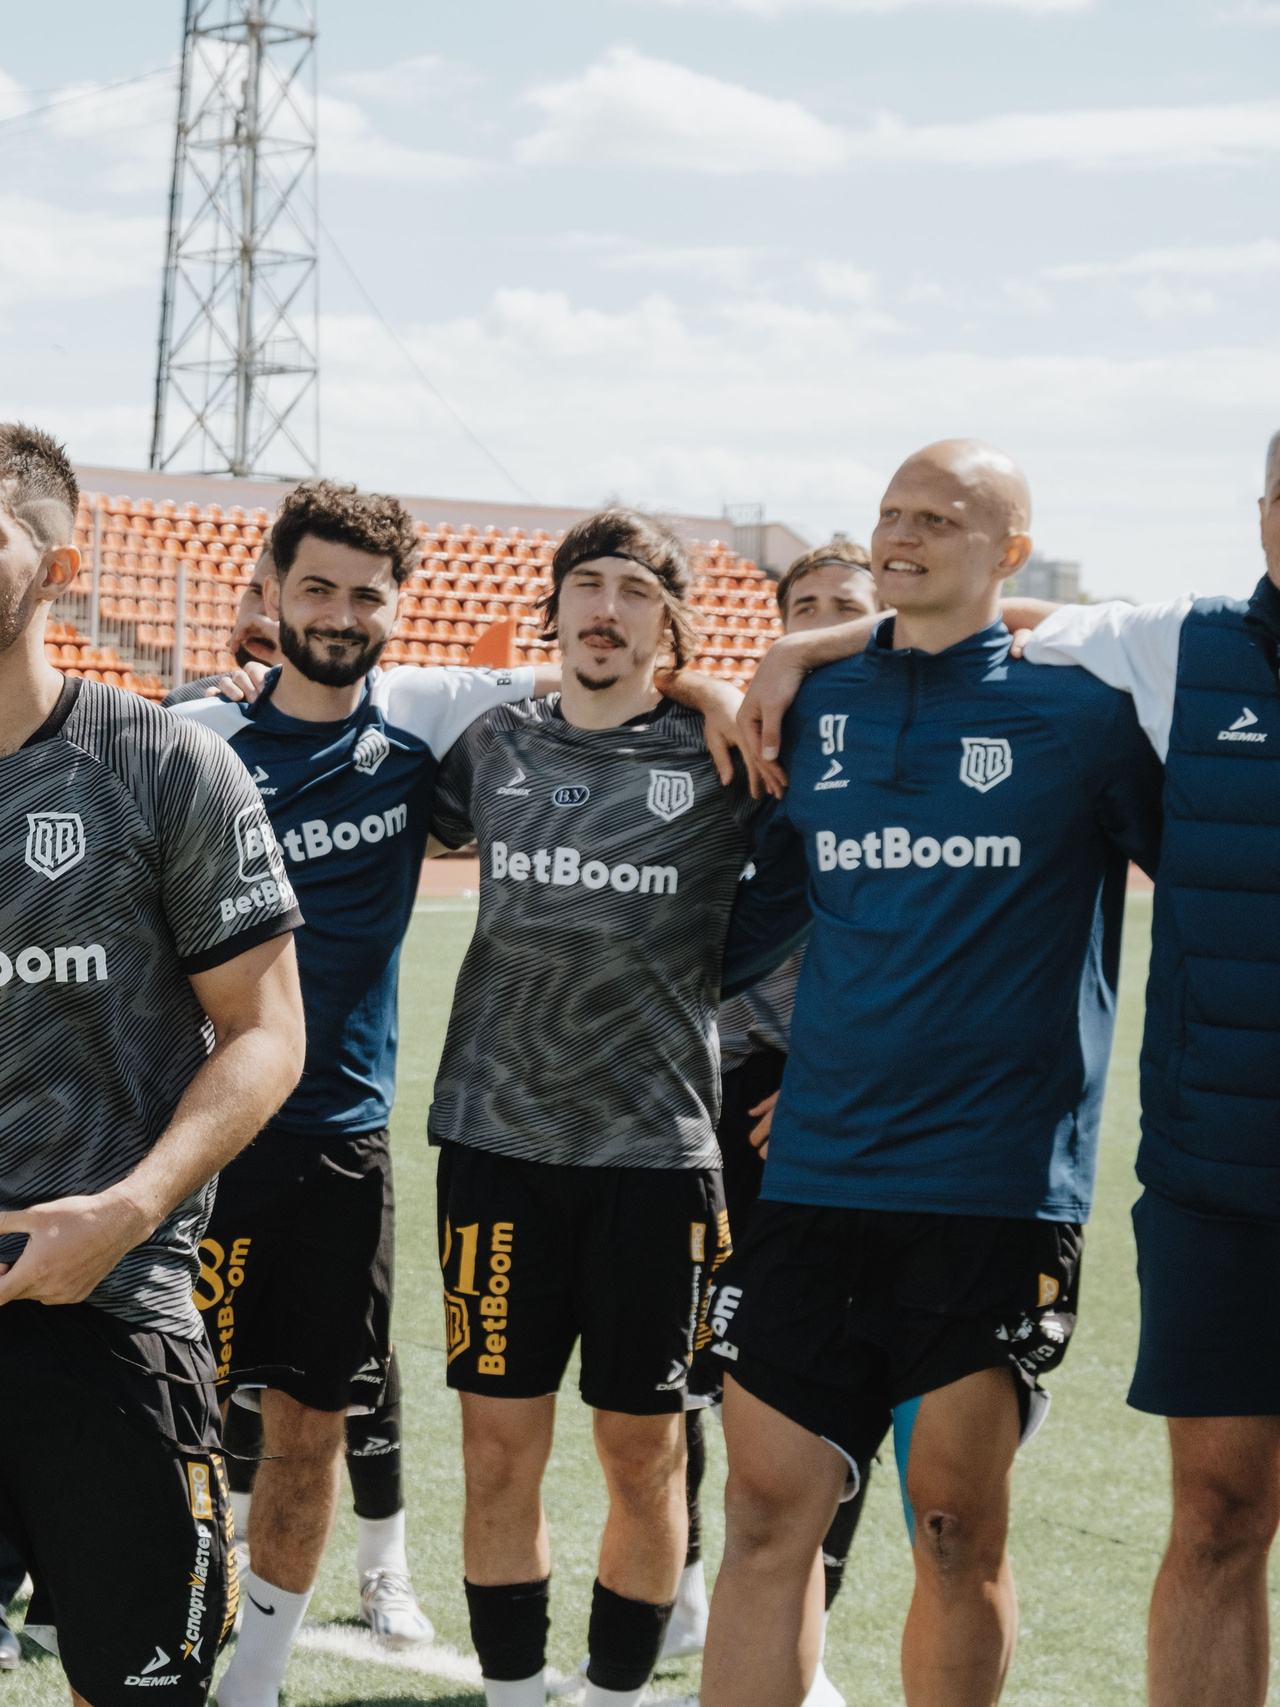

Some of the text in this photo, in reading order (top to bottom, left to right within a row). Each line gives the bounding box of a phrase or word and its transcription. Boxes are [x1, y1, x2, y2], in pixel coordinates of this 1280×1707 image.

[819, 714, 849, 755] 97
[1217, 731, 1268, 743] DEMIX
[496, 786, 532, 797] DEMIX
[813, 779, 851, 791] DEMIX
[277, 803, 407, 862] tBoom
[816, 827, 1021, 872] BetBoom
[491, 841, 678, 894] BetBoom
[477, 1222, 514, 1376] BetBoom
[192, 1465, 210, 1517] PRO
[124, 1674, 182, 1688] DEMIX
